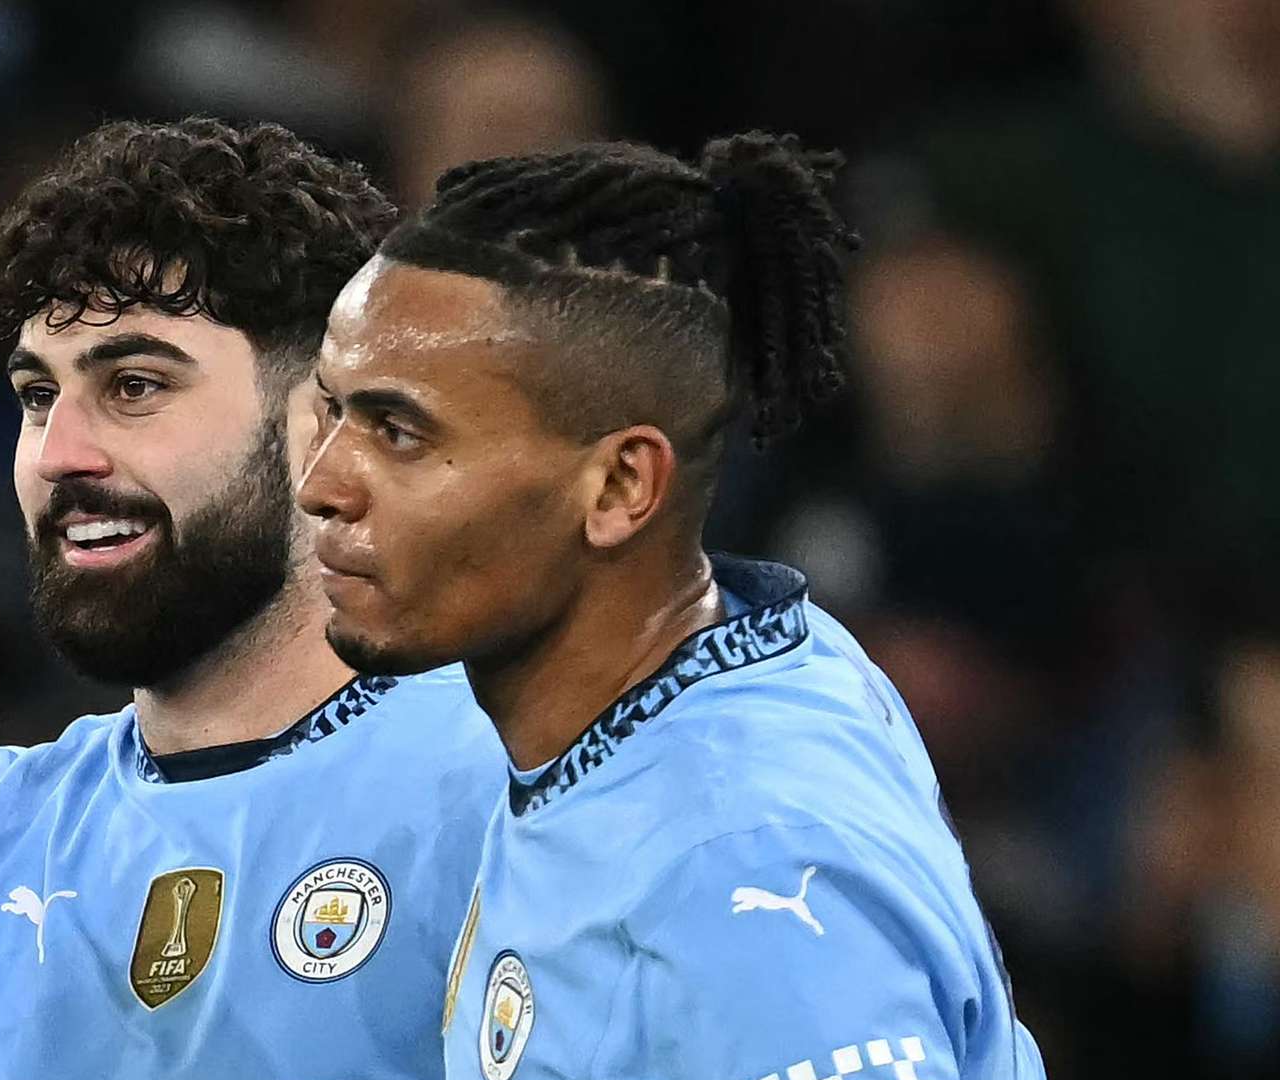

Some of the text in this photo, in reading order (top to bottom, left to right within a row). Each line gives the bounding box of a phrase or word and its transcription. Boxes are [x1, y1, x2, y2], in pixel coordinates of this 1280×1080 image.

[292, 867, 382, 906] MANCHESTER
[149, 958, 185, 977] FIFA
[302, 961, 337, 974] CITY
